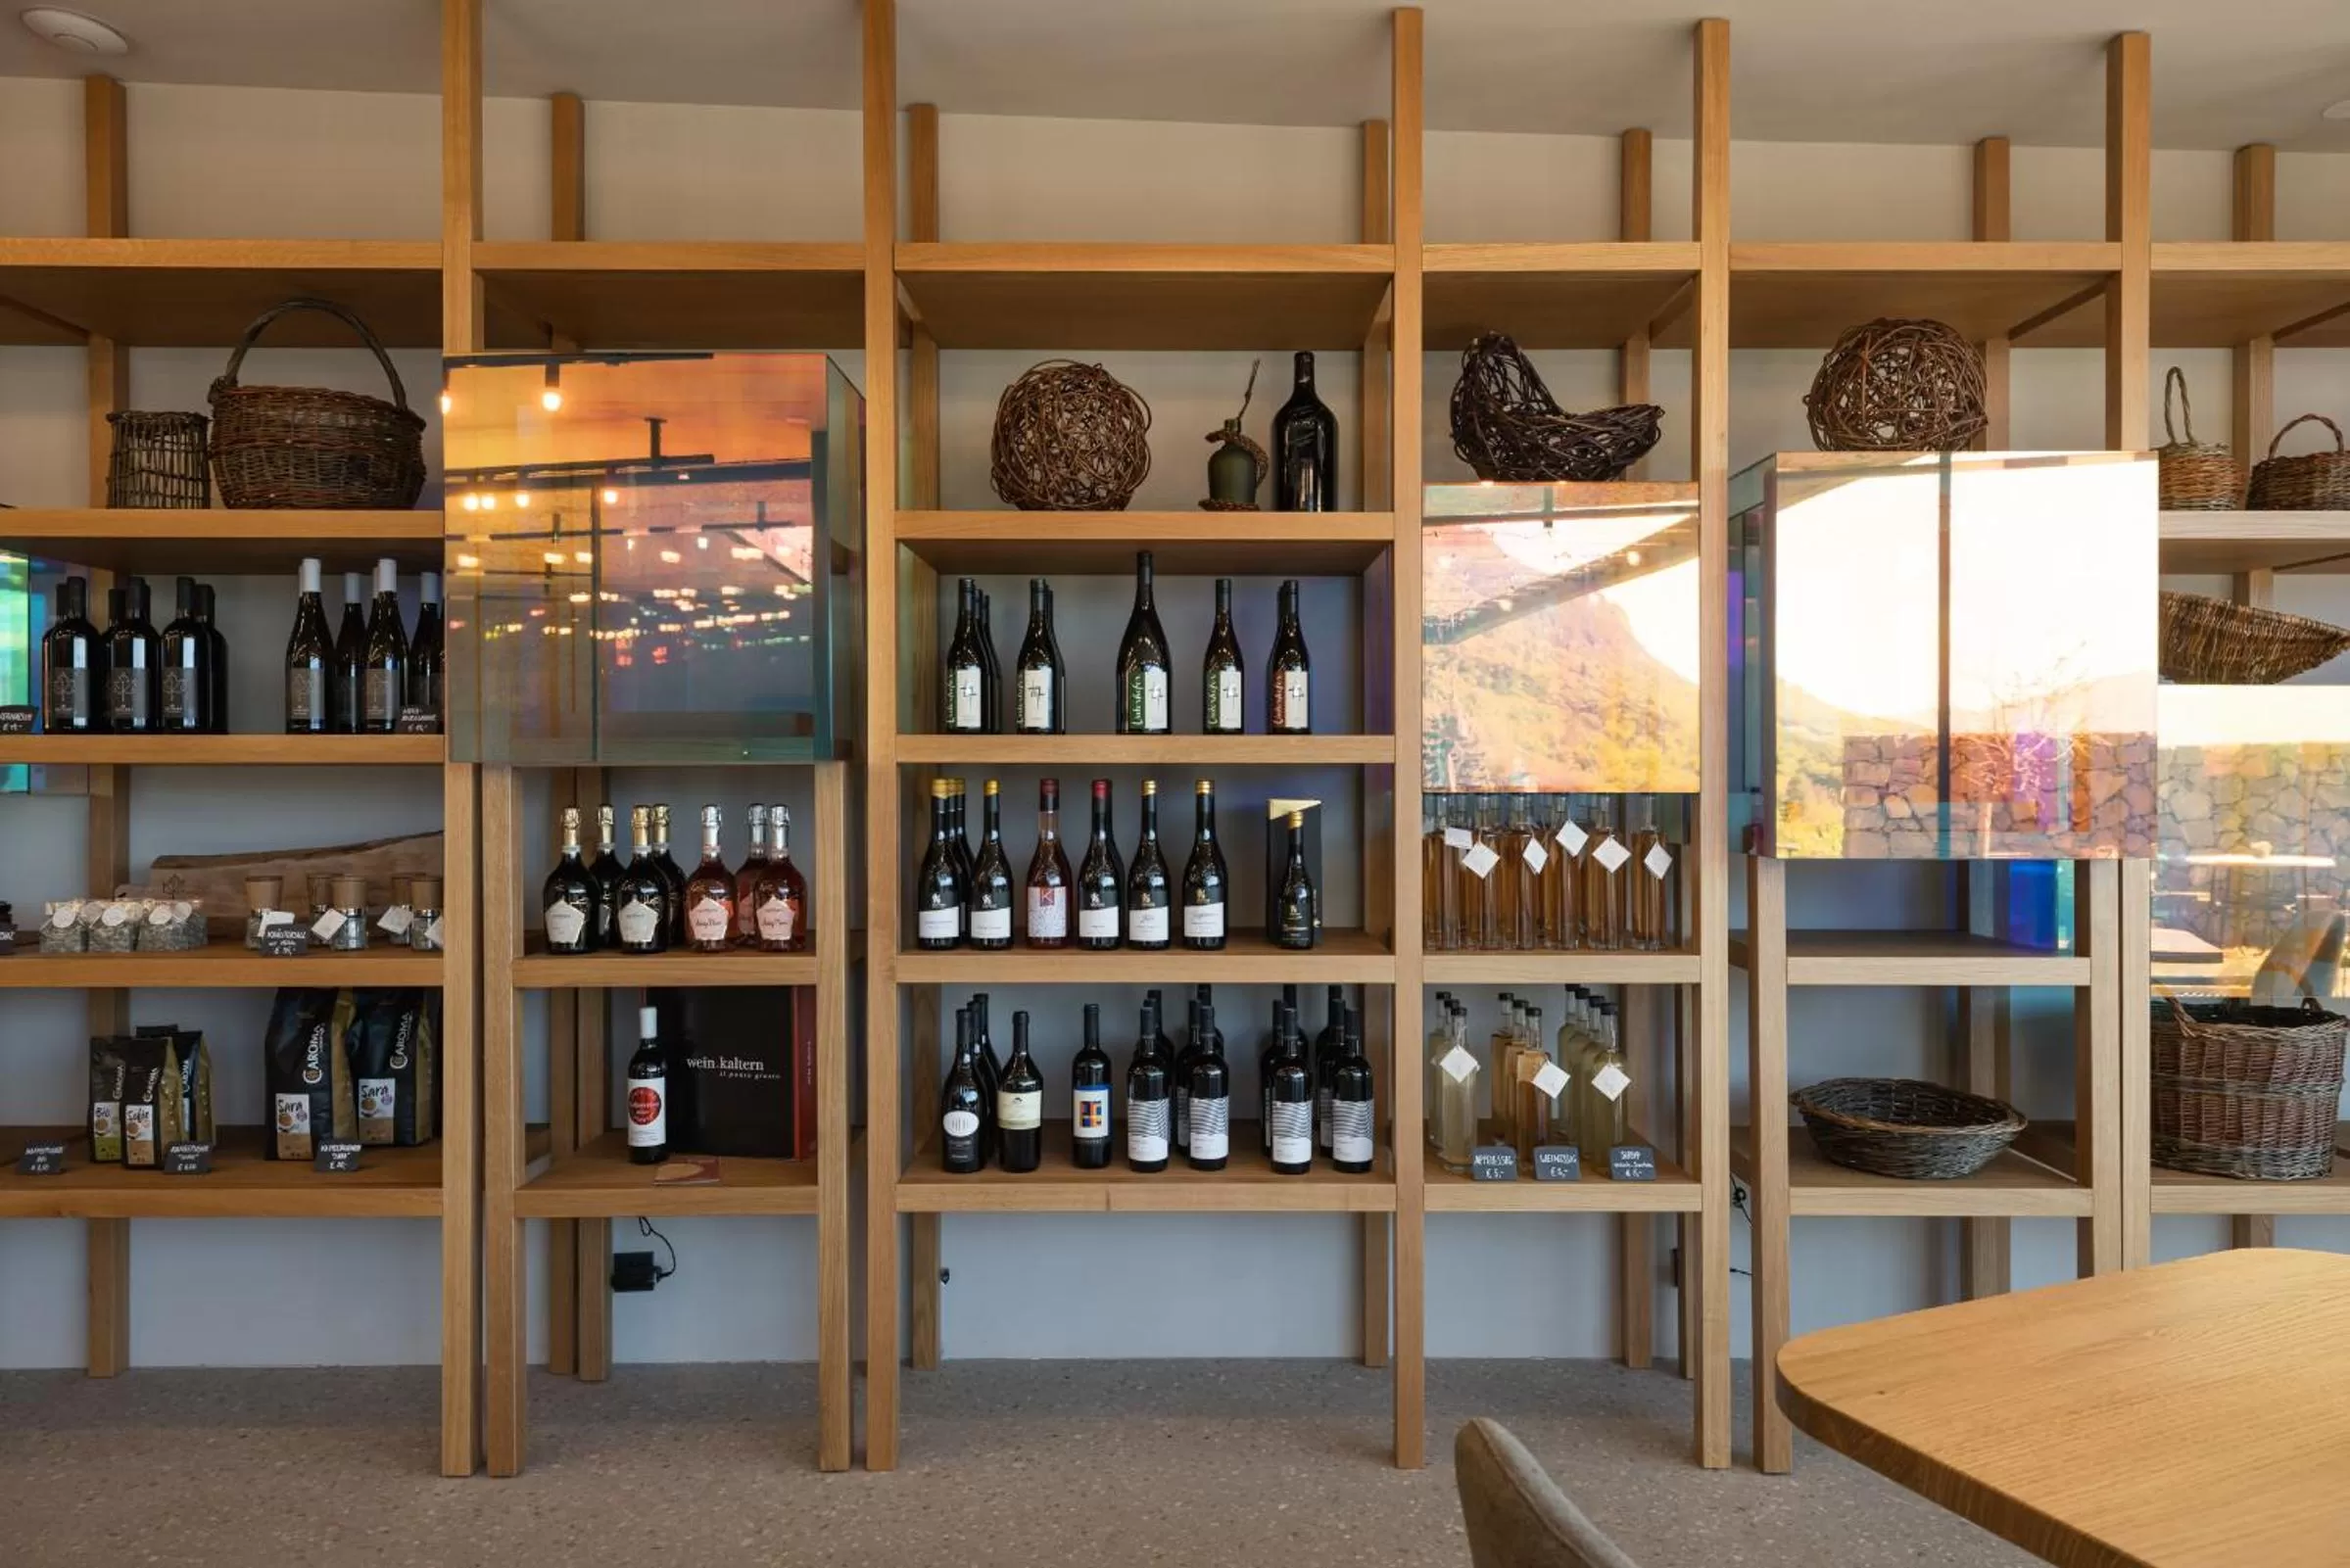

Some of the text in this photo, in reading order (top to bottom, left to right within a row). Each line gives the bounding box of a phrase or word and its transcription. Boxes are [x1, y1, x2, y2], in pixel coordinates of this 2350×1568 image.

[1041, 888, 1054, 903] K
[390, 1012, 409, 1069] CAROMA
[303, 1023, 322, 1084] CAROMA
[360, 1084, 389, 1099] Sara
[277, 1098, 303, 1114] Sara
